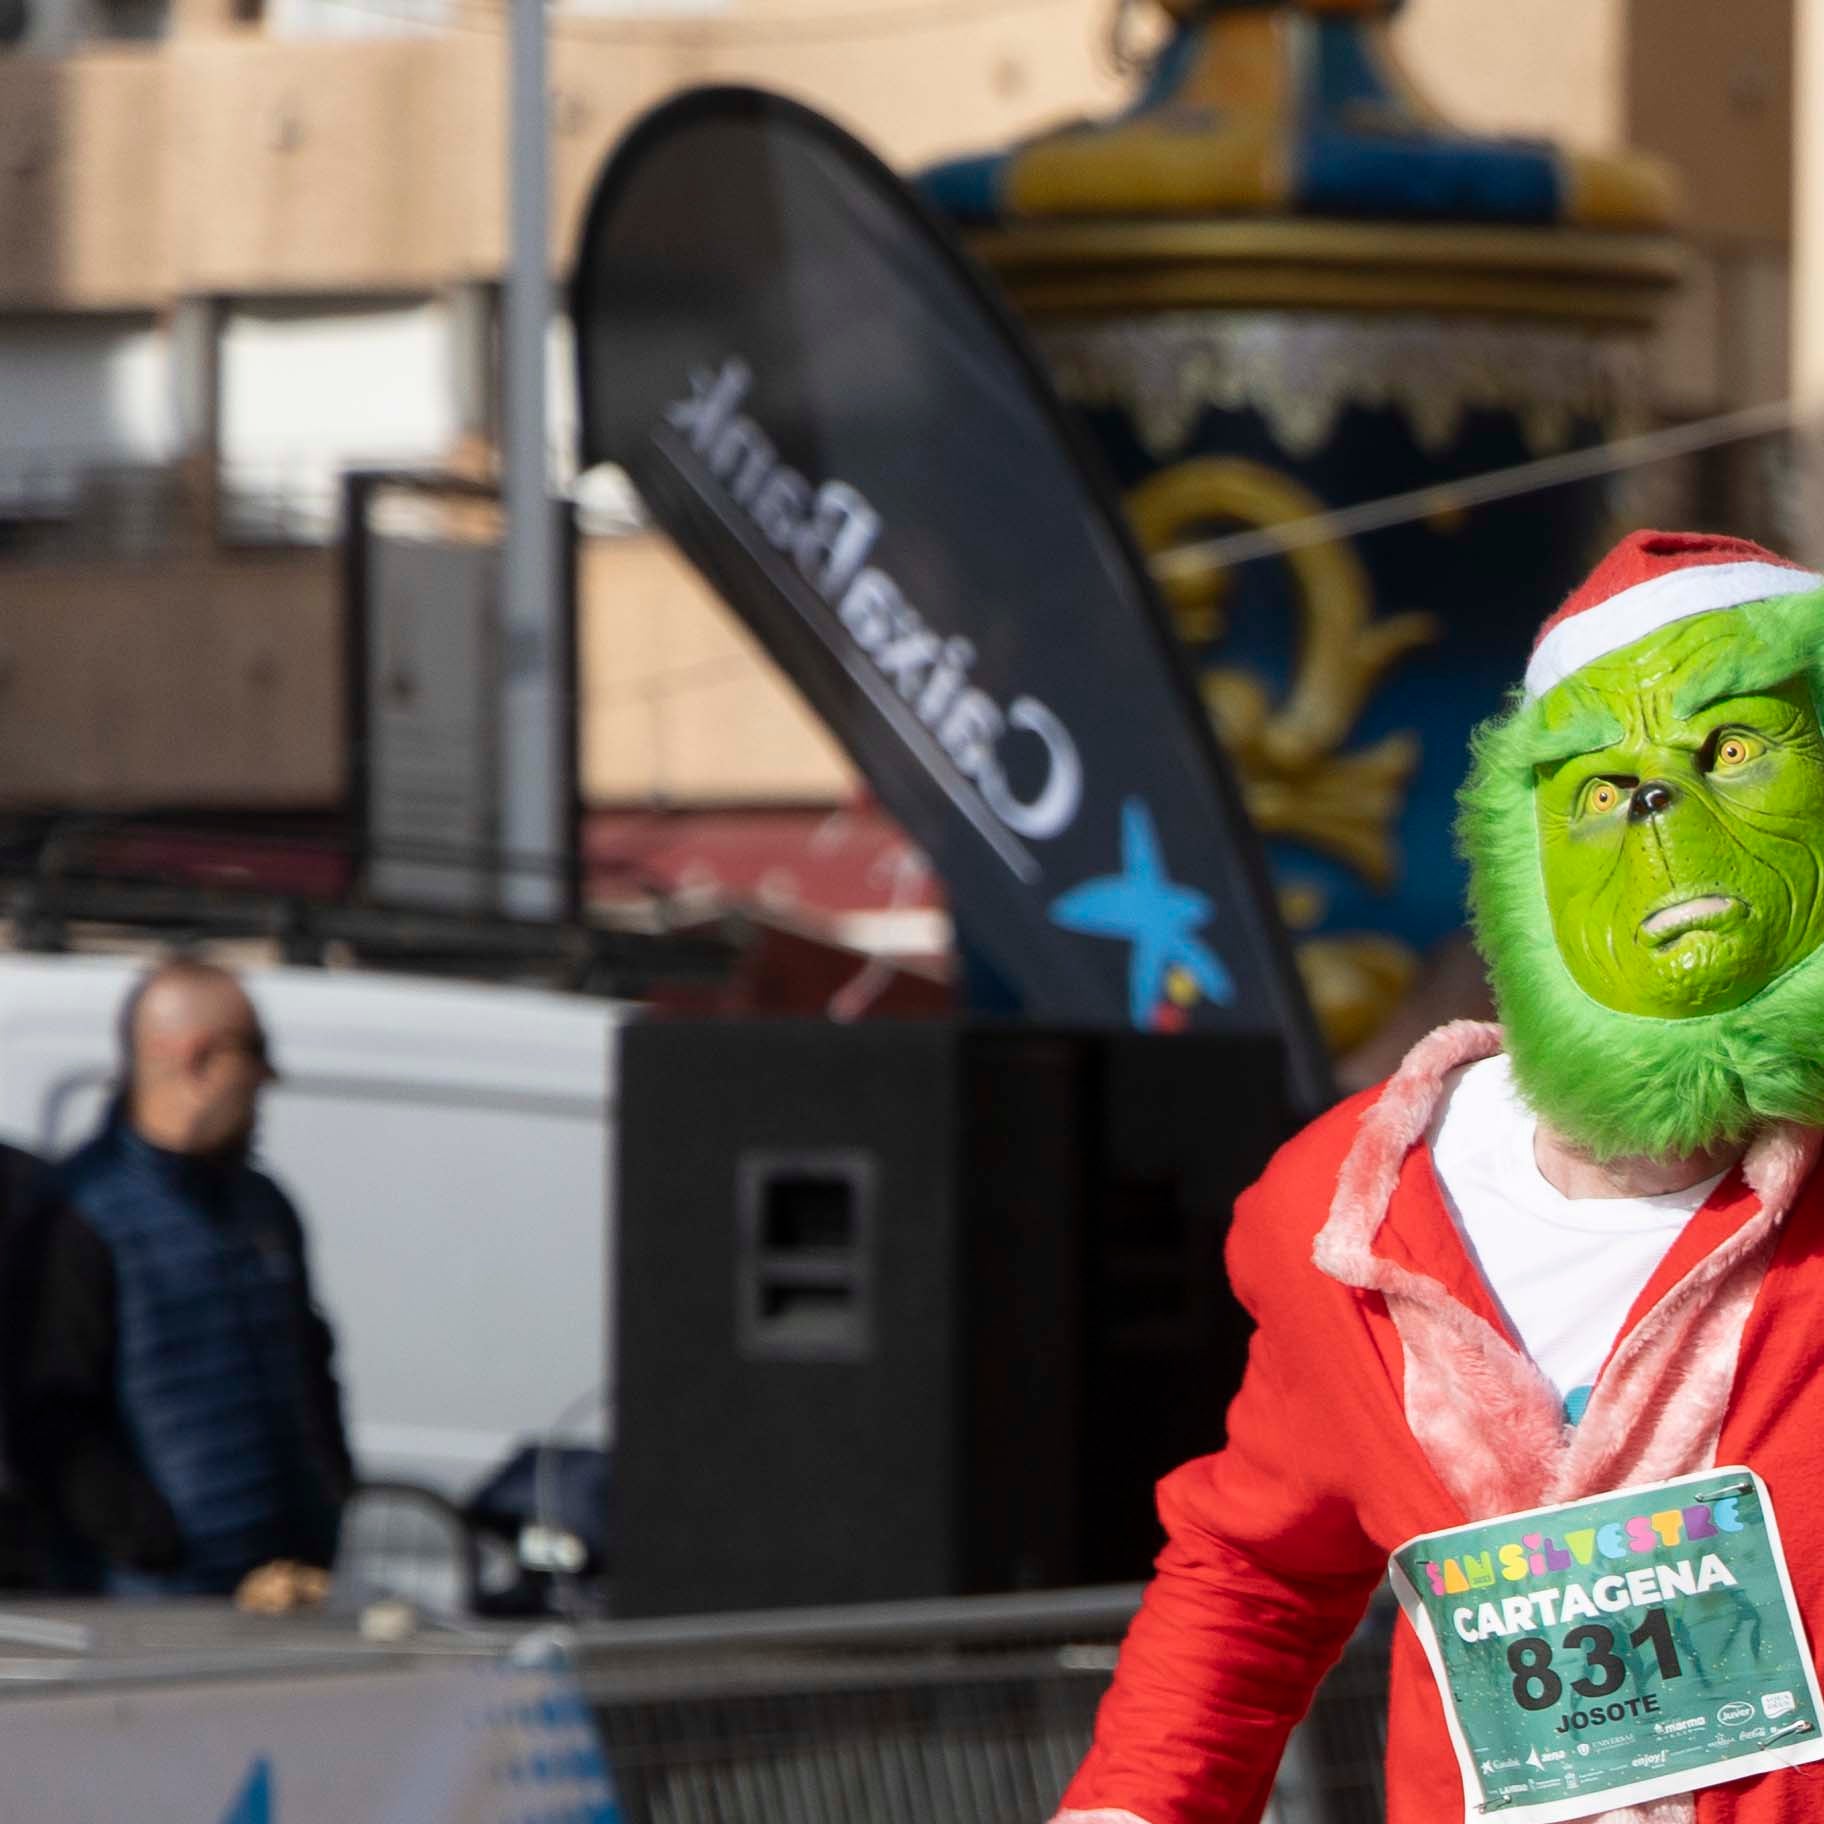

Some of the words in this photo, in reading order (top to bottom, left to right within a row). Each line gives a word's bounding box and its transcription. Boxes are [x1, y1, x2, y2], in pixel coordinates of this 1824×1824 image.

[1425, 1551, 1495, 1596] SAN
[1453, 1553, 1738, 1642] CARTAGENA
[1506, 1609, 1683, 1711] 831
[1556, 1694, 1660, 1733] JOSOTE
